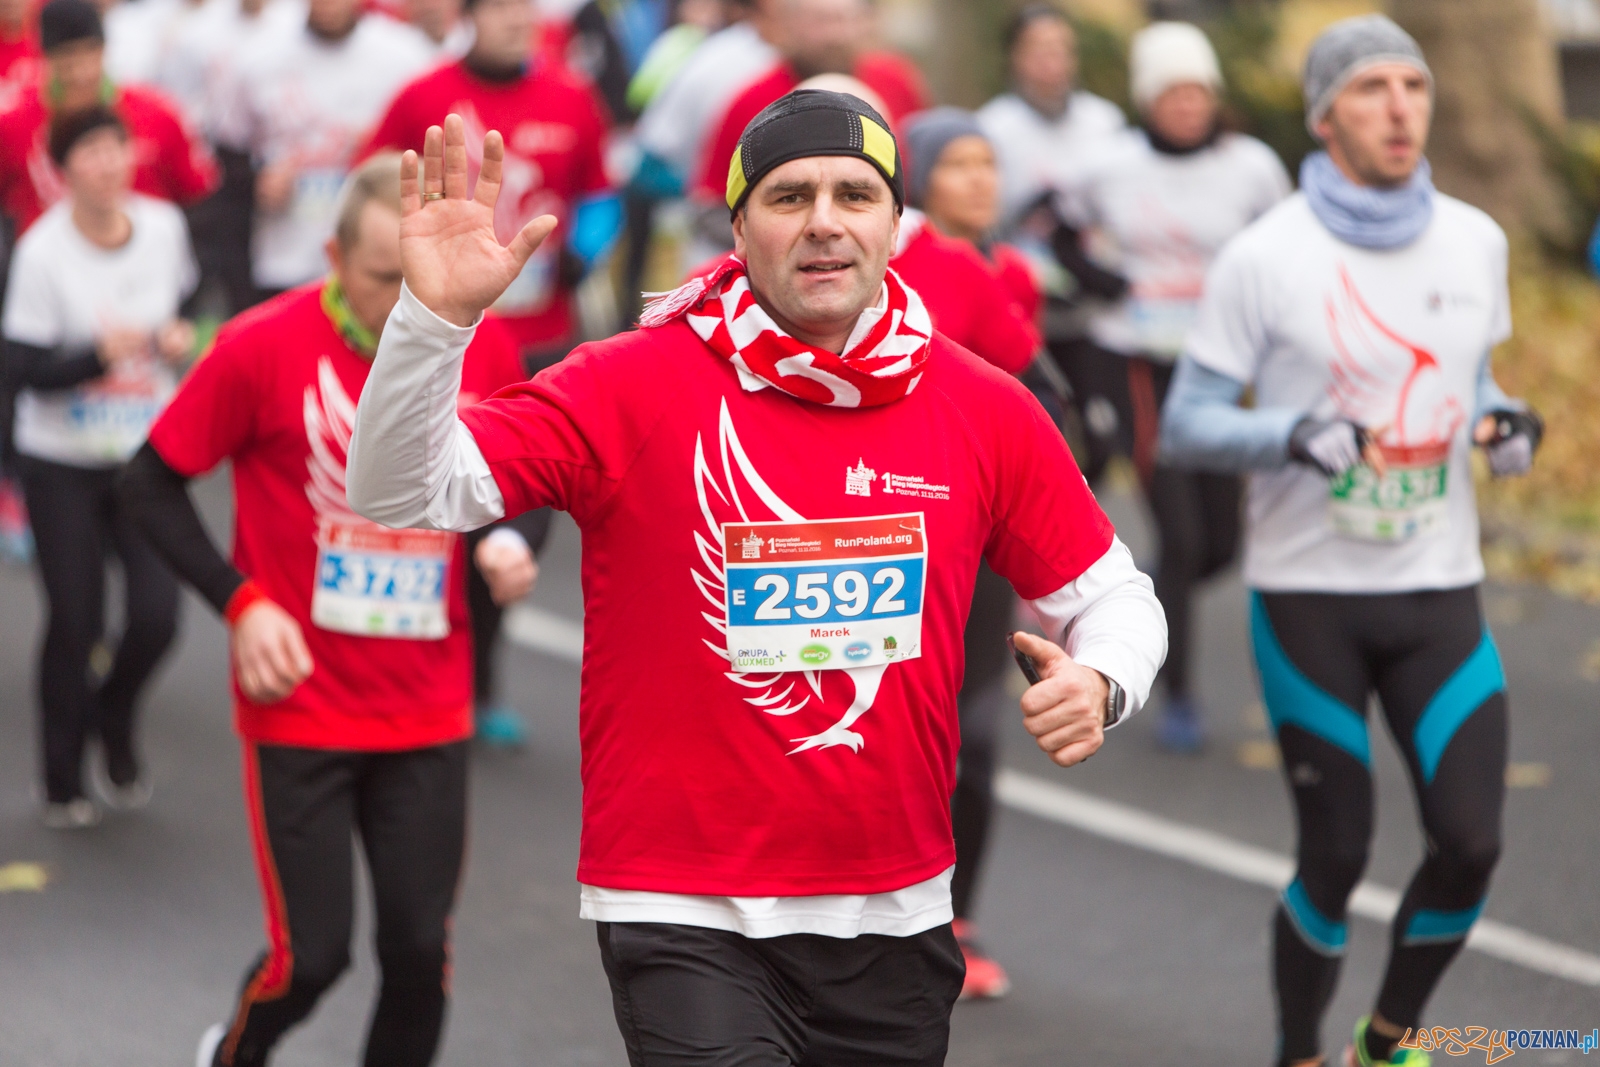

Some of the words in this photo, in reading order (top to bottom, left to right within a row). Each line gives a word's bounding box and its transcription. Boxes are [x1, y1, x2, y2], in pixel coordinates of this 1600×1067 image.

[881, 472, 894, 494] 1
[767, 537, 777, 554] 1
[834, 534, 912, 548] RunPoland.org
[732, 589, 746, 605] E
[753, 567, 906, 620] 2592
[810, 627, 850, 638] Marek
[737, 649, 769, 657] GRUPA
[737, 657, 775, 666] LUXMED
